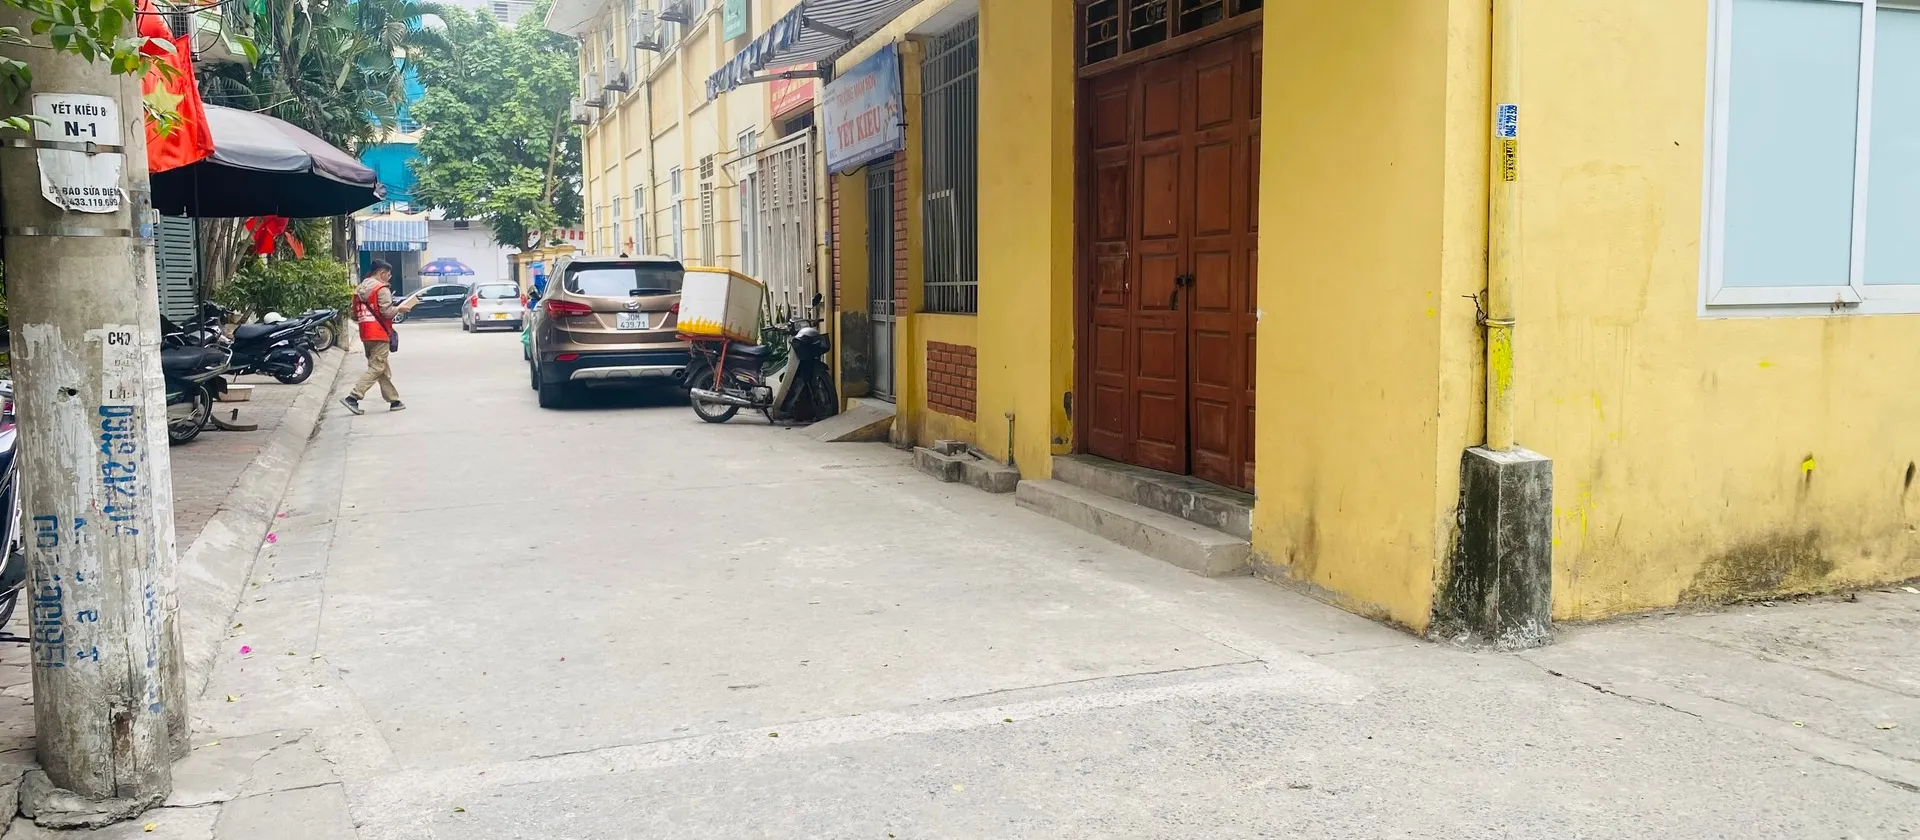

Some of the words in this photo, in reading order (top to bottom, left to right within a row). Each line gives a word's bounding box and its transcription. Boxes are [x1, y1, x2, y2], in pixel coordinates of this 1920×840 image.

[51, 101, 71, 115] YẾT
[74, 103, 98, 116] KIÊU
[100, 107, 106, 117] 8
[64, 121, 97, 137] N-1
[837, 109, 854, 150] YẾT
[856, 102, 880, 142] KIÊU
